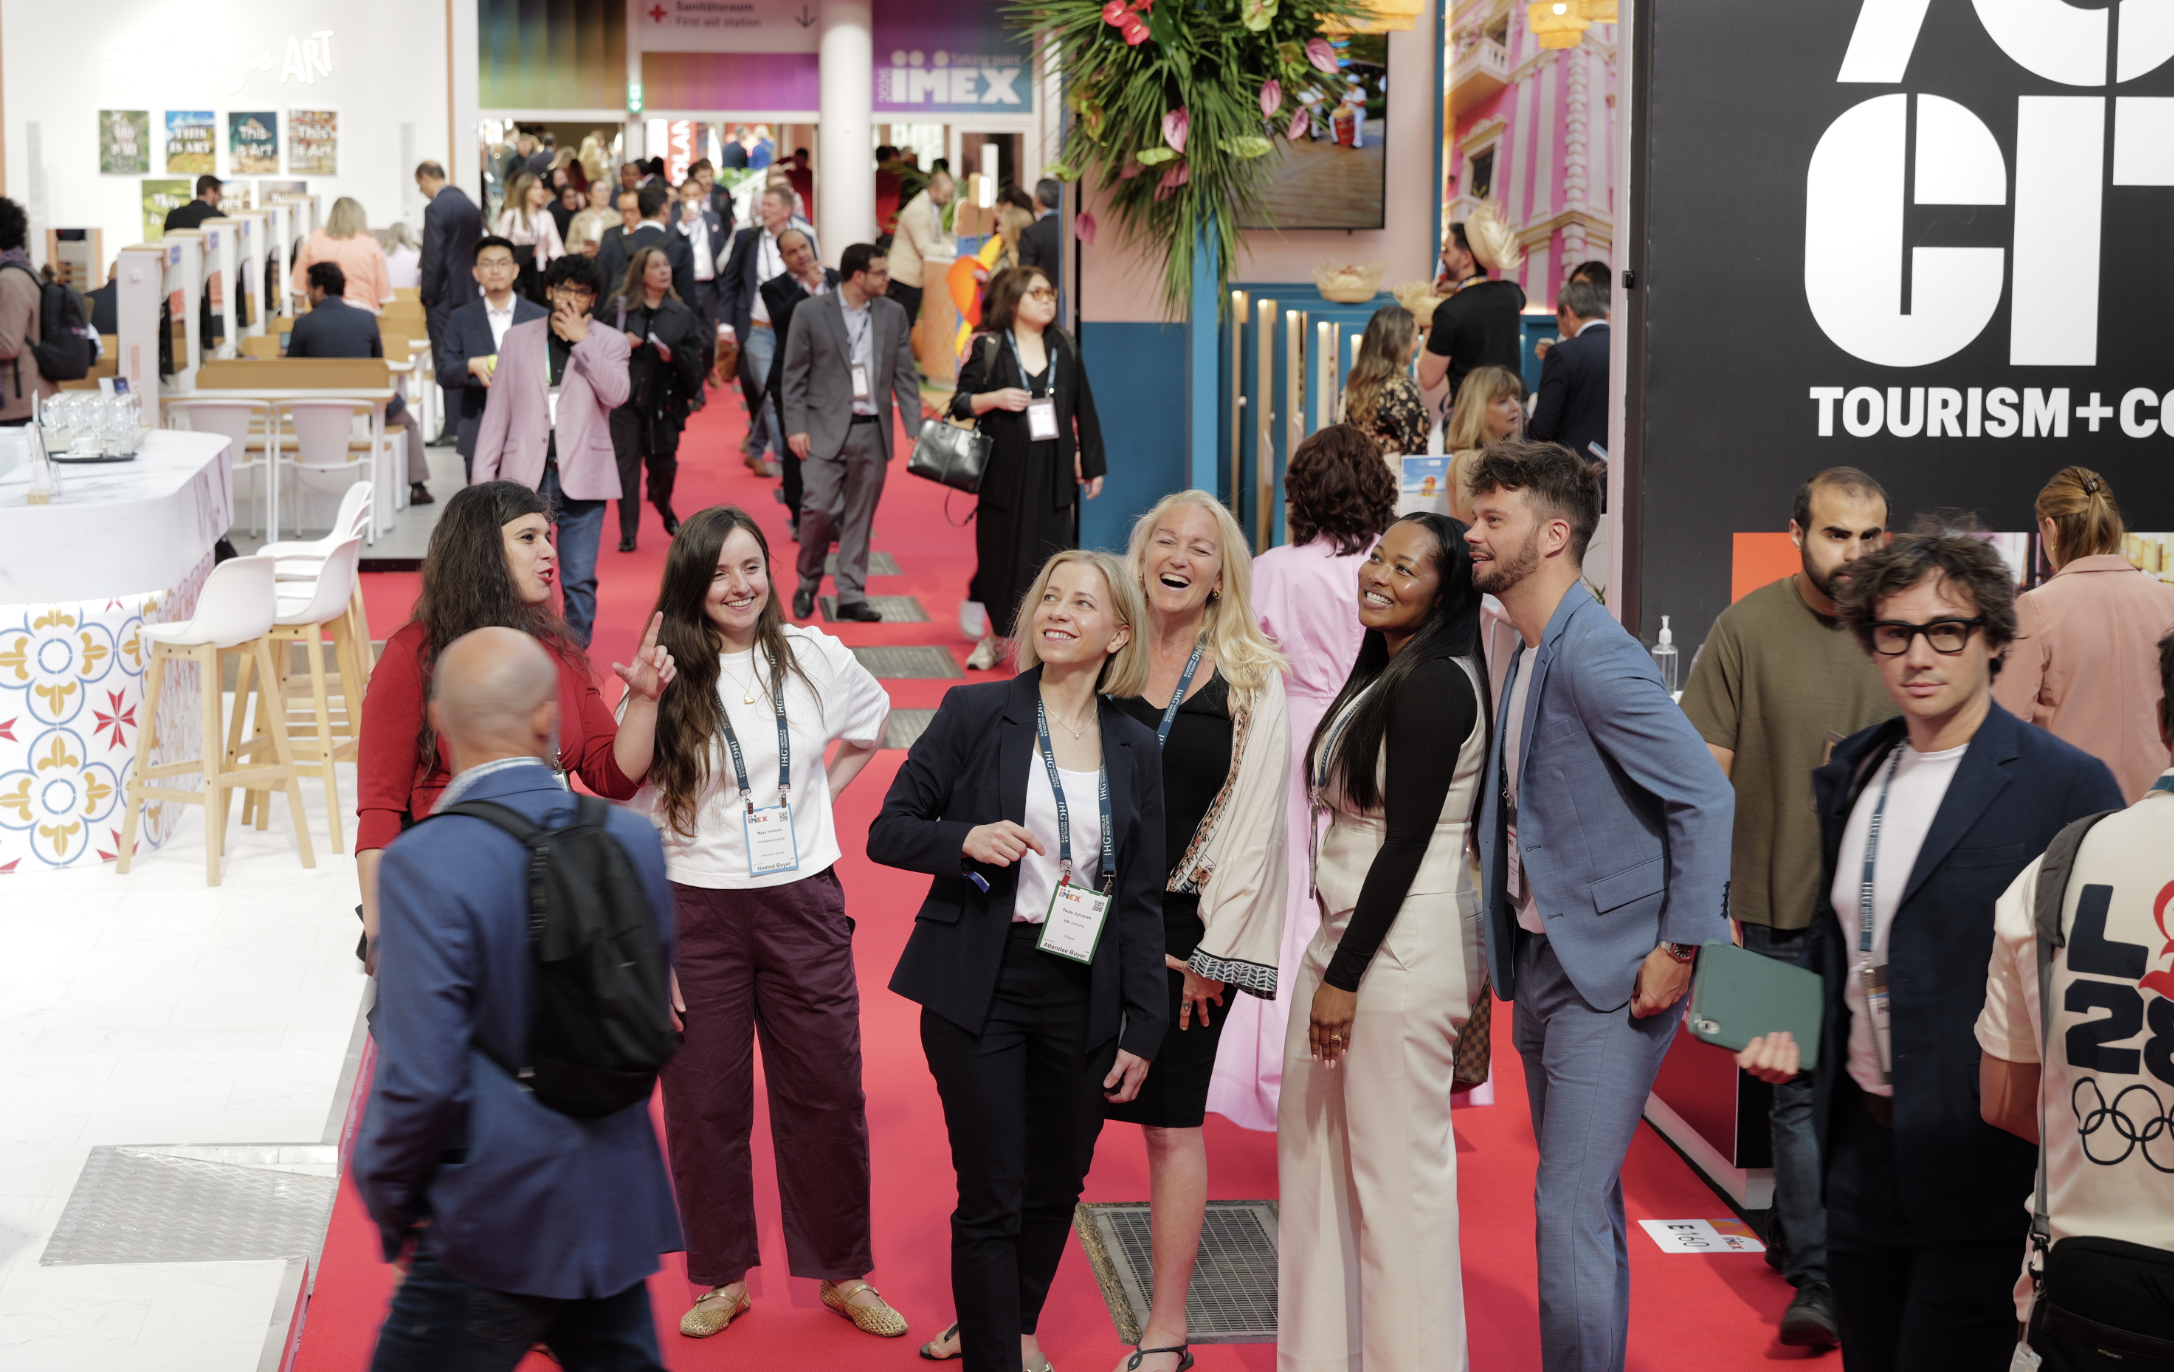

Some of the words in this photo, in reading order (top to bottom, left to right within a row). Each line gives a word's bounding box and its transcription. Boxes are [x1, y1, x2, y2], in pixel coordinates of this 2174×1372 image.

[724, 17, 762, 27] station
[280, 30, 334, 85] ART
[238, 126, 267, 140] This
[297, 125, 328, 140] This
[234, 143, 247, 158] is
[249, 142, 274, 157] Art
[307, 142, 333, 157] Art
[1172, 689, 1184, 705] IHG
[730, 741, 741, 760] IHG
[781, 749, 789, 767] IHG
[1044, 751, 1055, 768] IHG
[1058, 802, 1068, 820] IHG
[1104, 837, 1112, 856] IHG
[757, 864, 776, 872] Hosted
[1043, 942, 1068, 954] Attendee
[1069, 949, 1086, 959] Buyer
